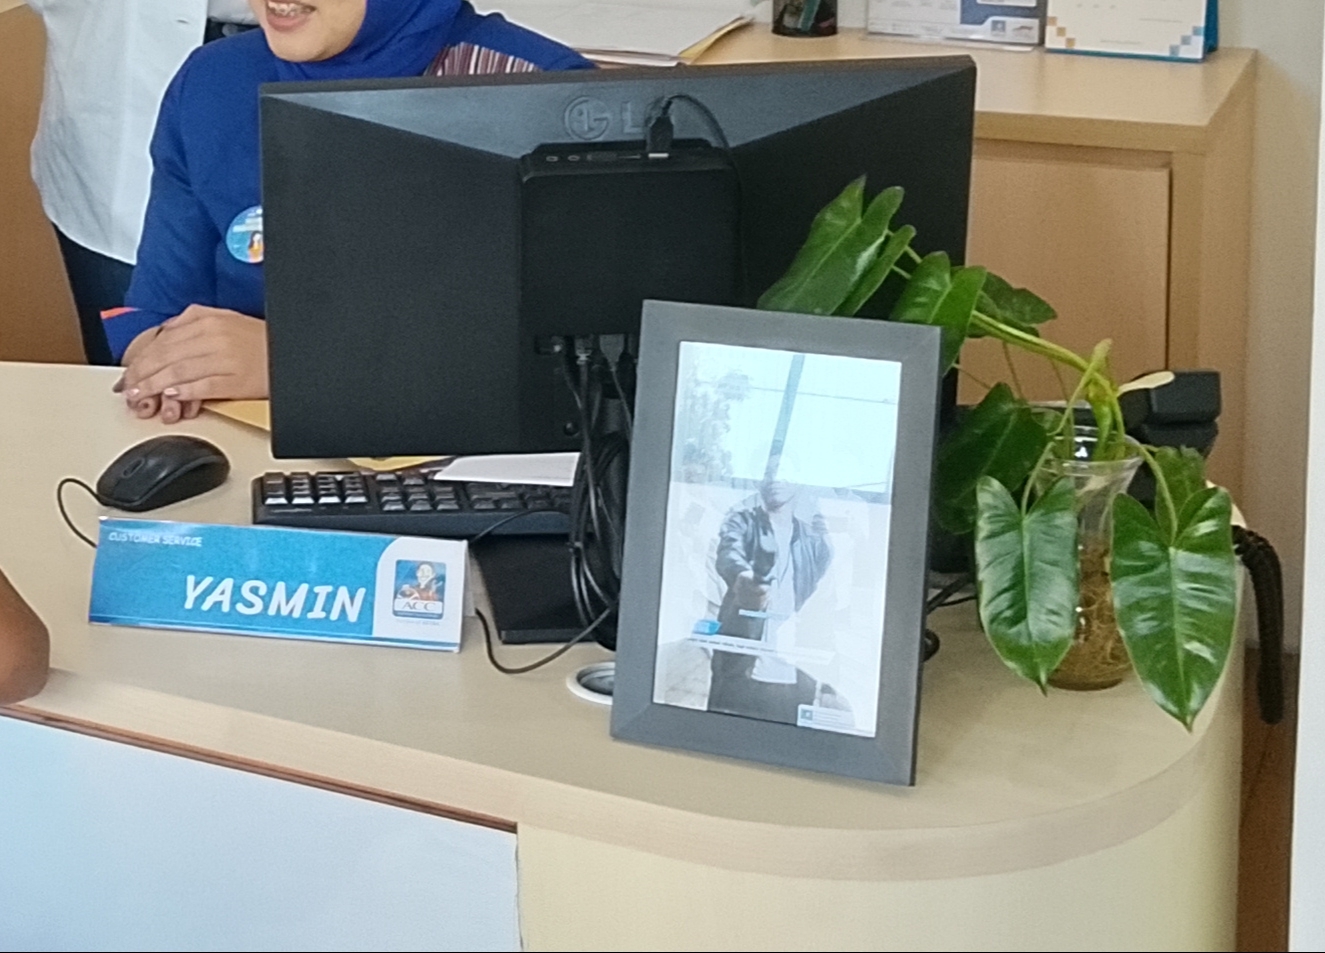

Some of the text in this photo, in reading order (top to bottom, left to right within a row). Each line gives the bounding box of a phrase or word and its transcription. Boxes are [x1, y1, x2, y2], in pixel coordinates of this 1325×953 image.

[108, 531, 202, 547] CUSTOMER SERVICE
[183, 574, 367, 623] YASMIN
[402, 600, 438, 612] ACC
